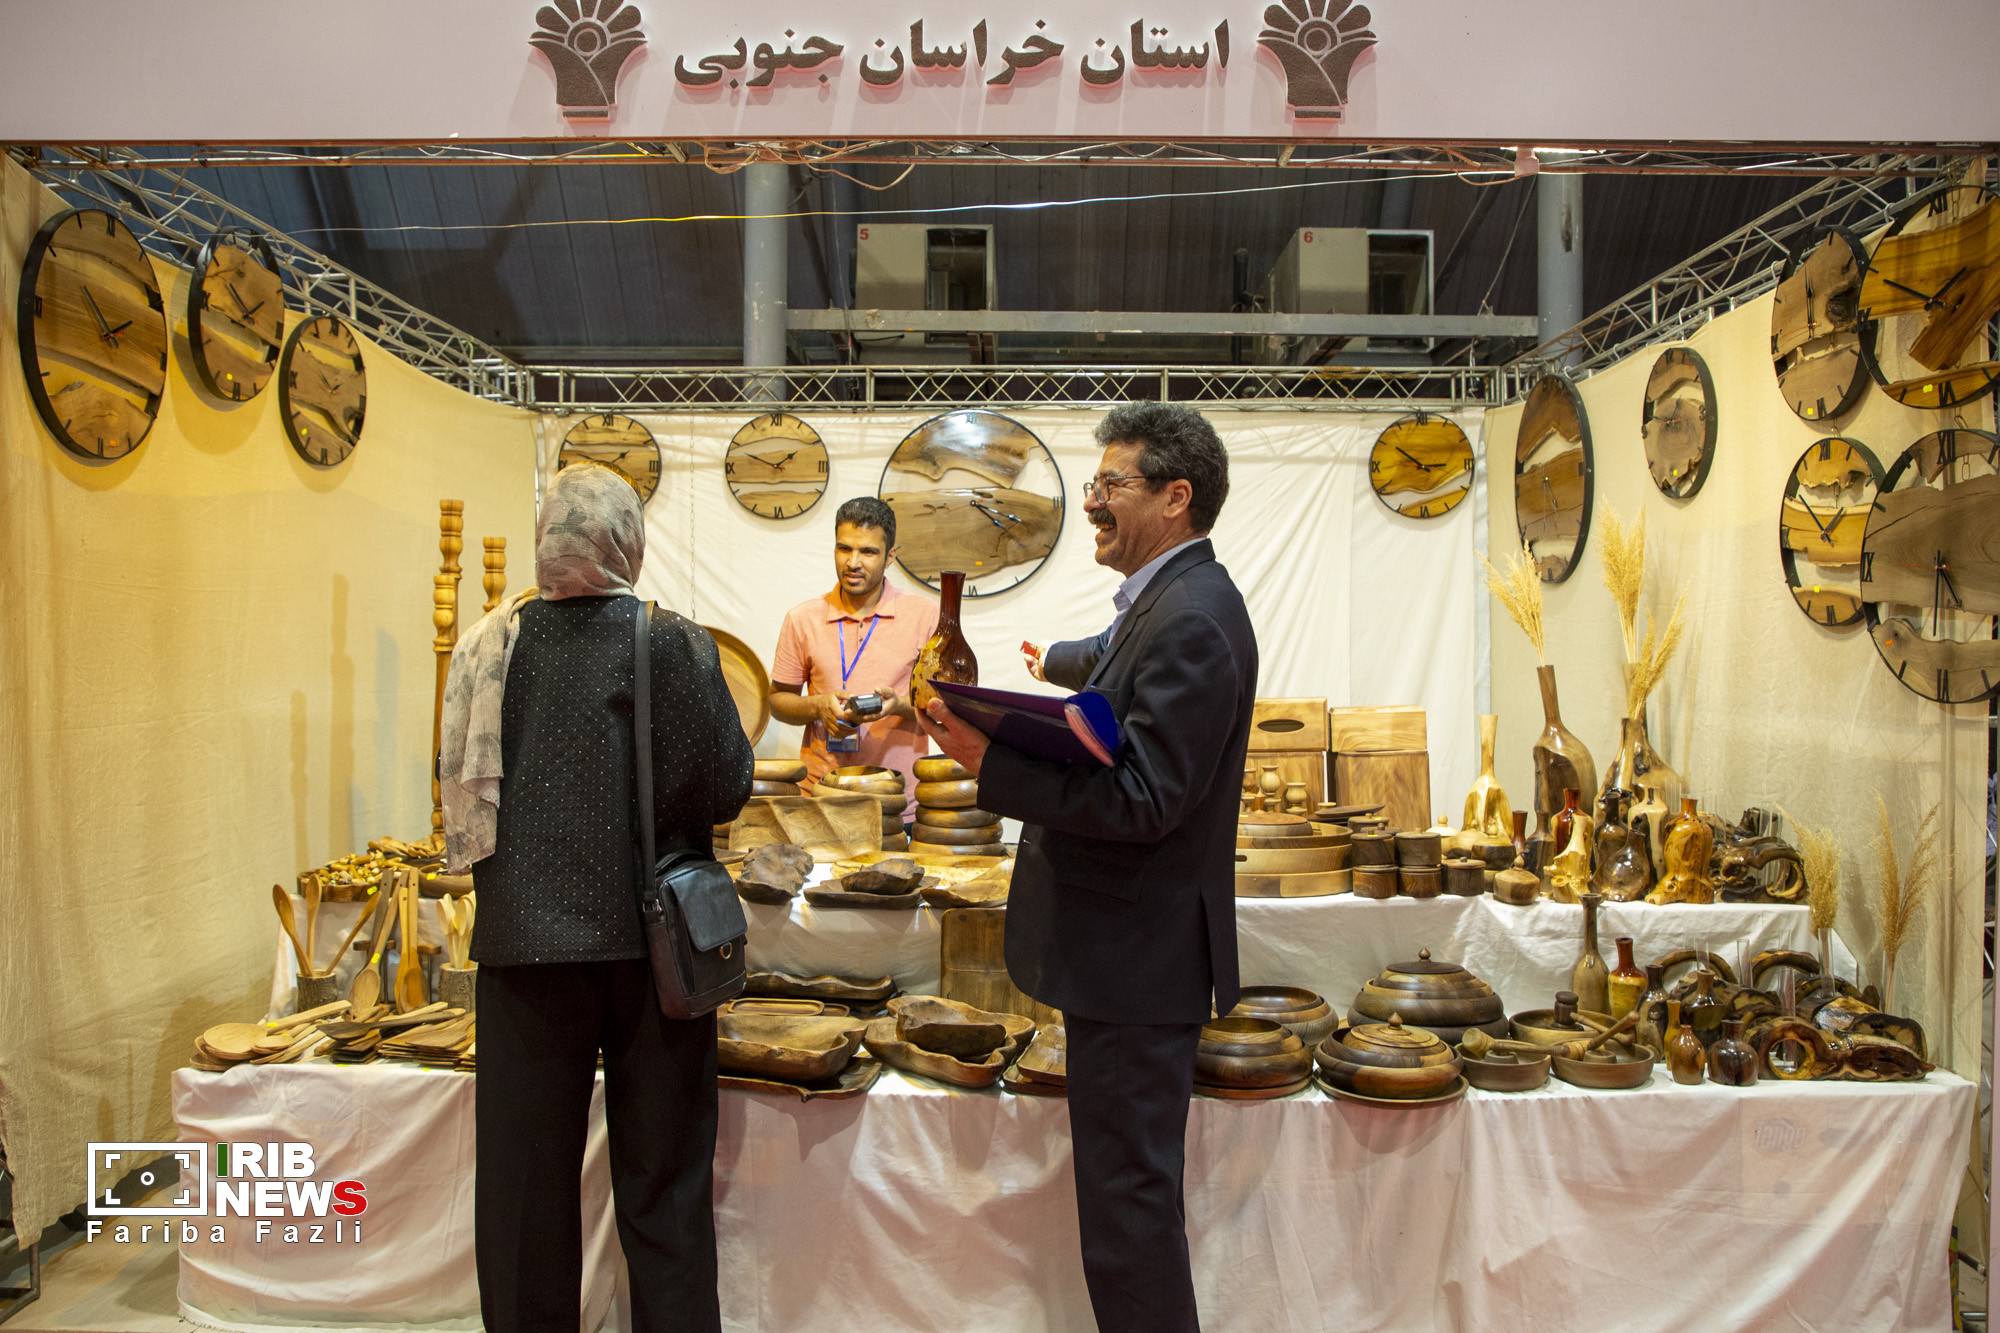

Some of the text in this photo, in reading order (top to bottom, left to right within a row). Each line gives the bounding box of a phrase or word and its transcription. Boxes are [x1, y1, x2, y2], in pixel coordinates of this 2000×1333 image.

[674, 19, 1230, 88] استان خراسان جنوبی
[859, 228, 870, 240] 5
[1303, 231, 1314, 243] 6
[770, 413, 783, 427] XII
[818, 460, 829, 473] III
